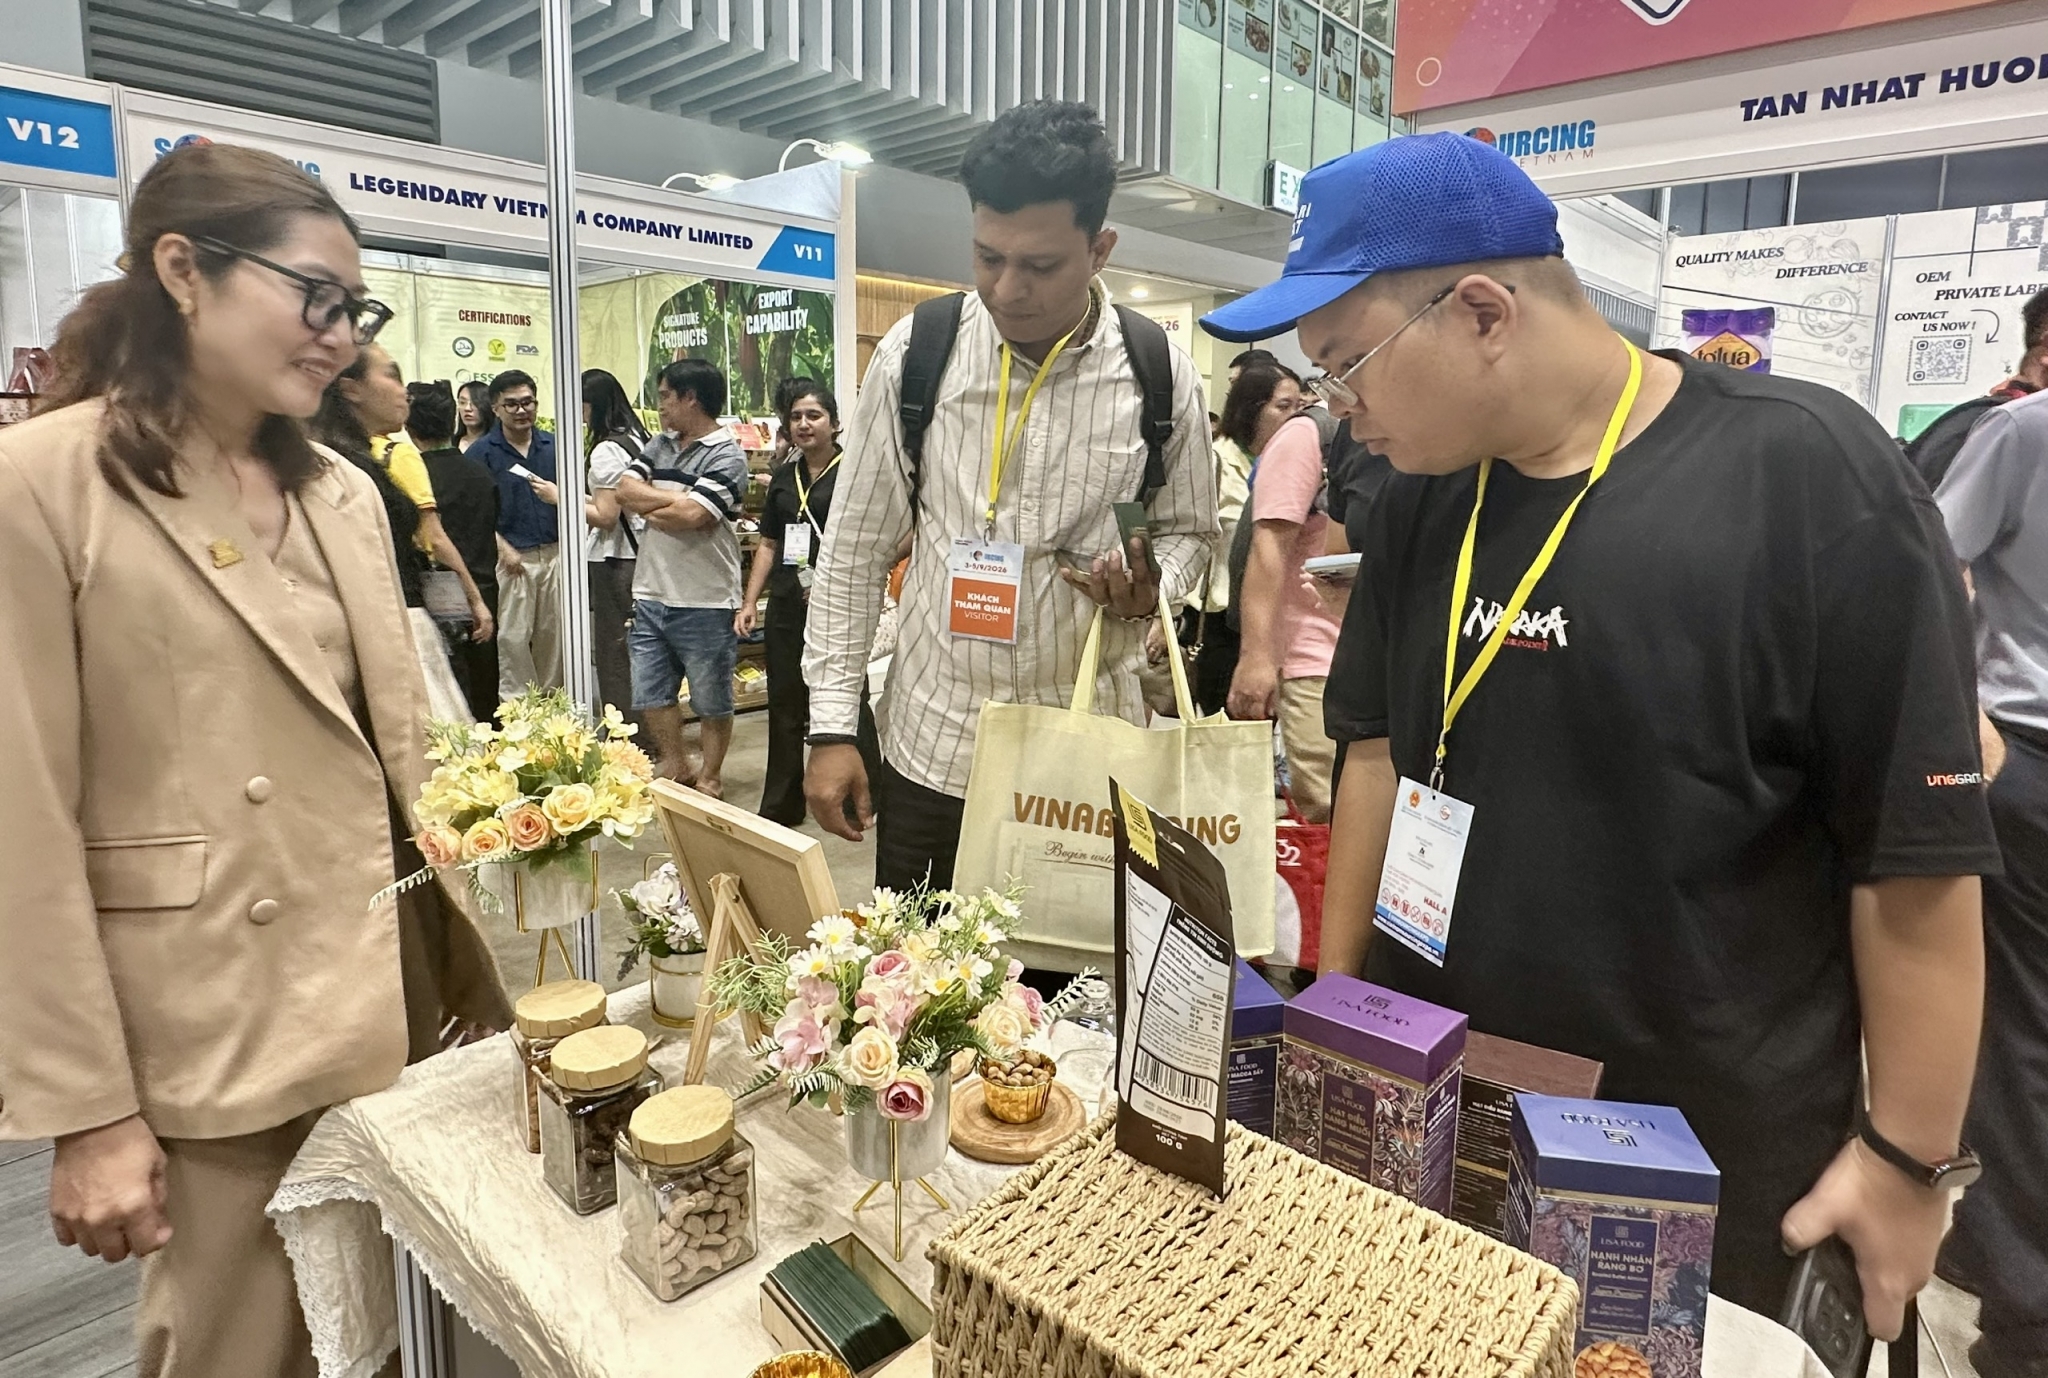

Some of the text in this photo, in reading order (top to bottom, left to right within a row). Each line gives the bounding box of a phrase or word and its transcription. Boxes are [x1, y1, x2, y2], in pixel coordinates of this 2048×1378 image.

[1740, 91, 1807, 122] TAN
[1821, 73, 1926, 110] NHAT
[6, 116, 80, 149] V12
[349, 173, 753, 250] LEGENDARY VIETNM COMPANY LIMITED
[793, 243, 823, 262] V11
[1676, 247, 1785, 267] QUALITY MAKES
[1775, 262, 1869, 280] DIFFERENCE
[1916, 271, 1952, 284] OEM
[758, 288, 793, 310] EXPORT
[1934, 286, 2001, 301] PRIVATE
[458, 309, 531, 327] CERTIFICATIONS
[663, 312, 699, 328] SIGNATURE
[745, 306, 809, 335] CAPABILITY
[1894, 311, 1949, 322] CONTACT
[1923, 323, 1938, 332] US
[659, 328, 708, 349] PRODUCTS
[516, 345, 539, 353] FDA
[964, 562, 1007, 574] 3-5/9/2026
[967, 592, 1000, 603] KHÁCH
[954, 600, 1011, 615] THAM QUAN
[964, 610, 999, 622] VISITOR
[1044, 840, 1087, 864] Begin
[1423, 896, 1440, 911] HALL
[1156, 1134, 1173, 1146] 100
[1597, 1261, 1627, 1272] RANG
